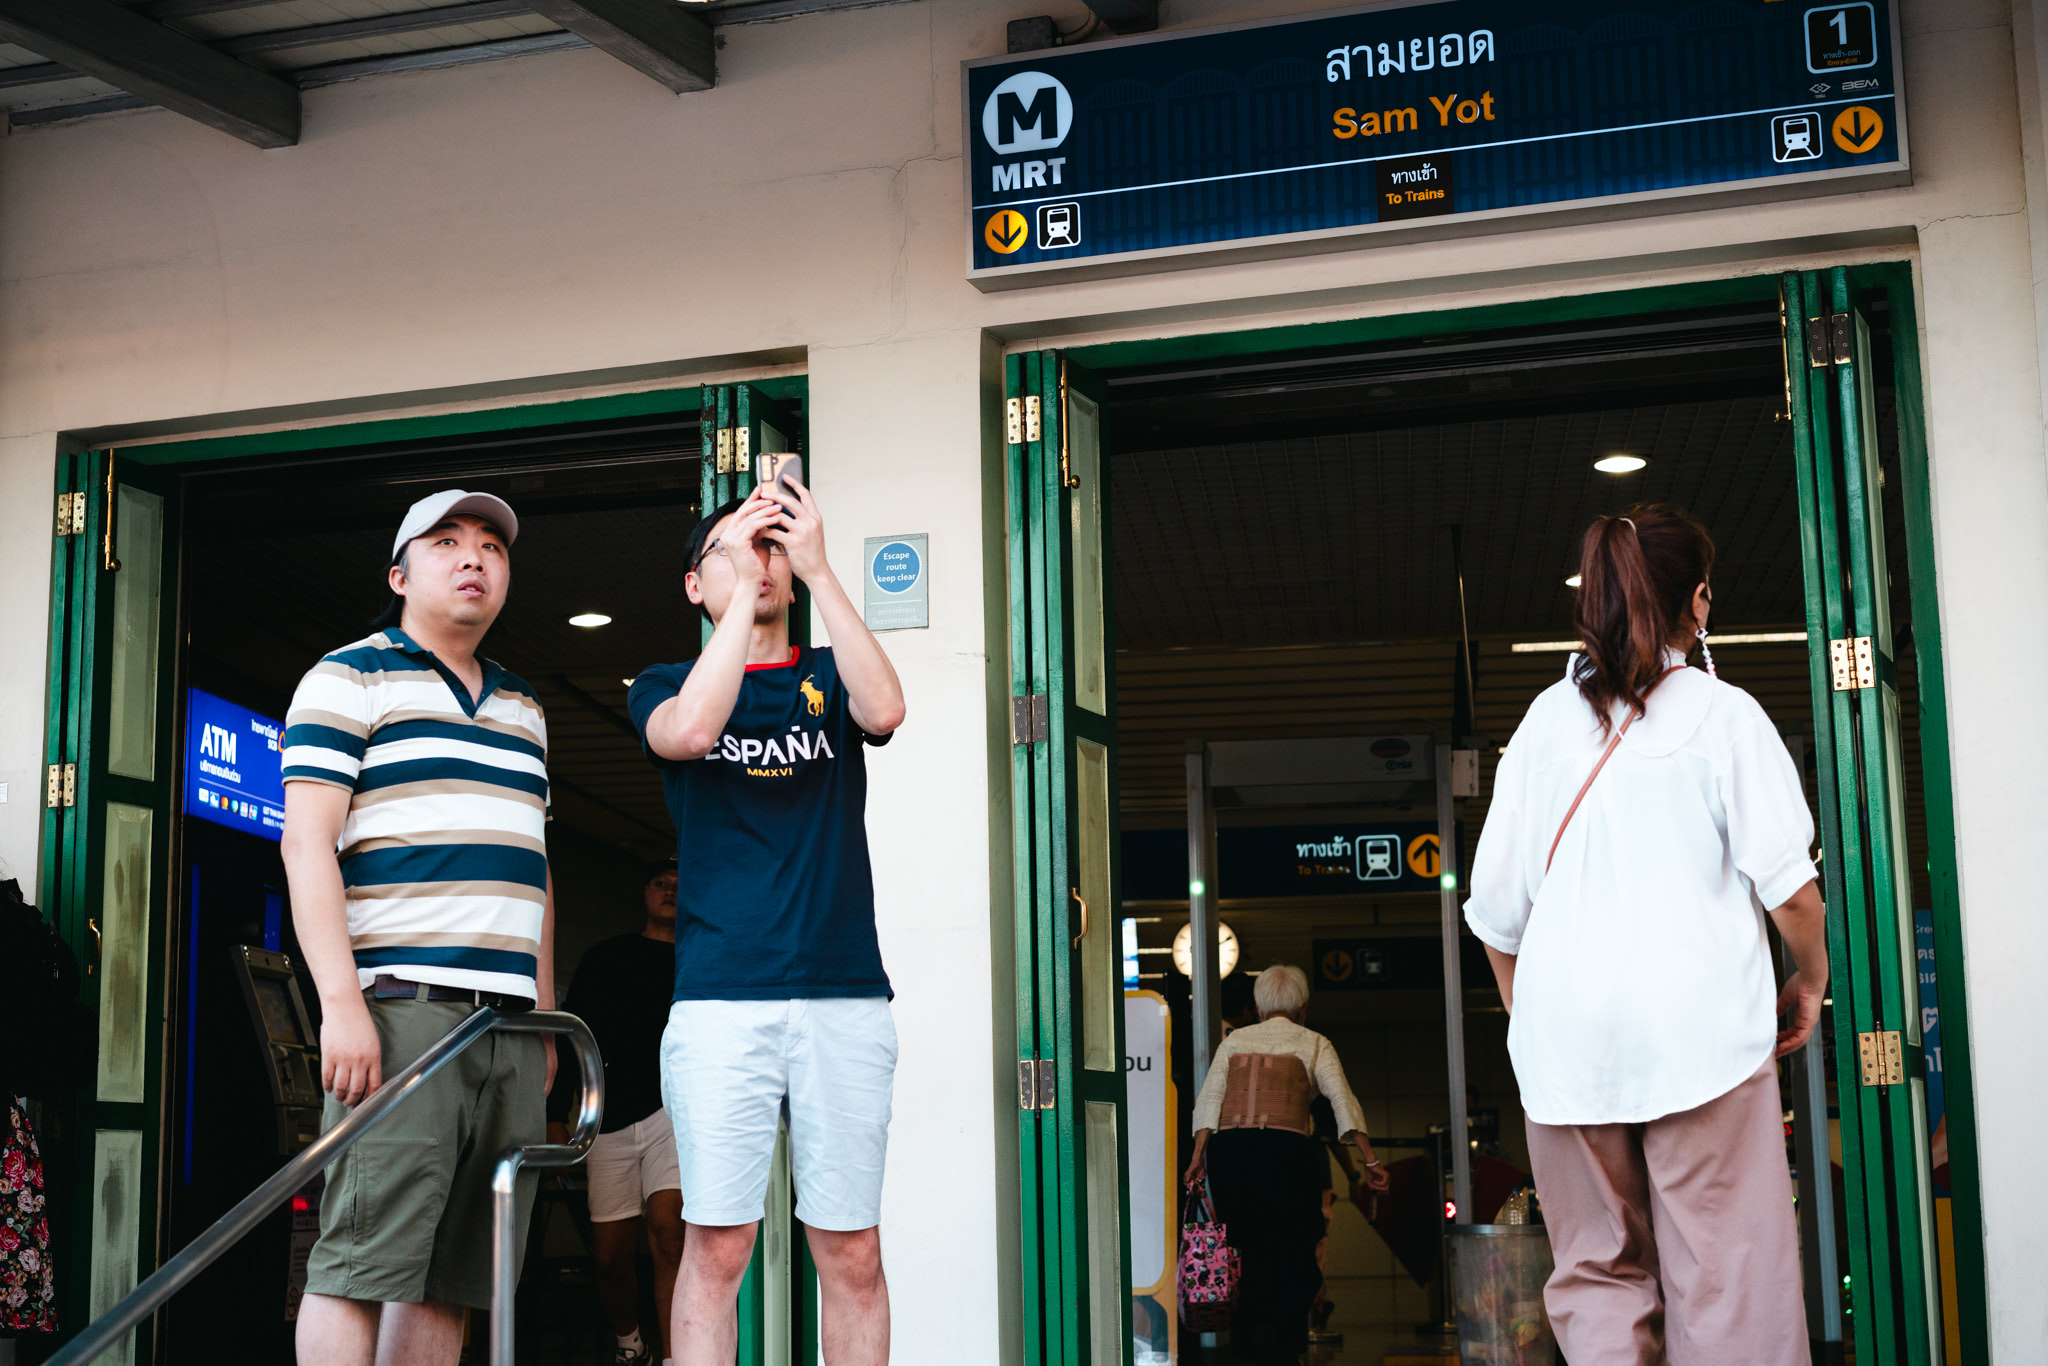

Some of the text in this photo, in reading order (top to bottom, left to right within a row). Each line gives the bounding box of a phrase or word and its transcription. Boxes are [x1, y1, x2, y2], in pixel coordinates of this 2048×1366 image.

[1829, 10, 1847, 45] 1
[1326, 29, 1496, 83] สามยอด
[1841, 78, 1880, 90] BEM
[1332, 90, 1496, 140] Sam Yot
[992, 157, 1066, 192] MRT
[1391, 162, 1438, 185] ทางเข้า
[1385, 188, 1445, 205] To Trains
[883, 552, 910, 561] Escape
[886, 563, 907, 571] route
[877, 573, 916, 583] keep clear
[200, 722, 237, 765] ATM
[746, 767, 793, 777] MMXVI
[1296, 835, 1352, 858] ทางเข้า
